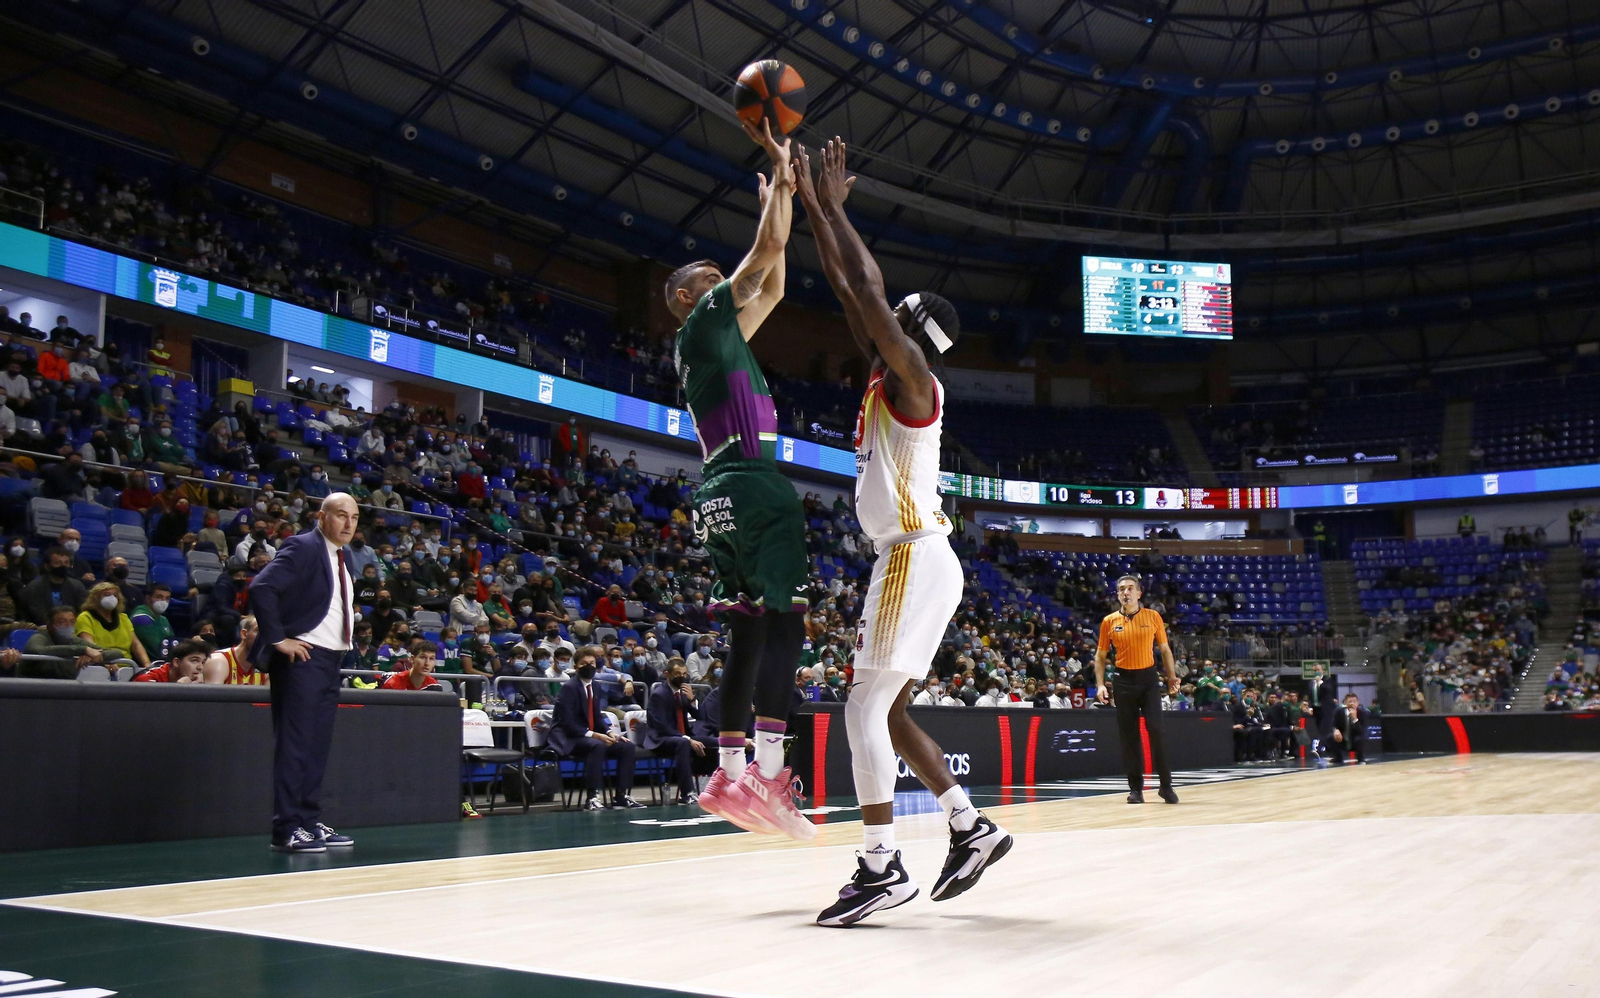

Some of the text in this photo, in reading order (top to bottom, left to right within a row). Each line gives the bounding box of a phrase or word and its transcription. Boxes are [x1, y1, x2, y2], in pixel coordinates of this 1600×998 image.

[1131, 262, 1145, 273] 10
[1170, 264, 1184, 275] 13
[1050, 487, 1068, 502] 10
[1115, 490, 1135, 505] 13
[701, 496, 733, 515] COSTA
[715, 510, 735, 523] SOL
[1073, 692, 1084, 708] 5
